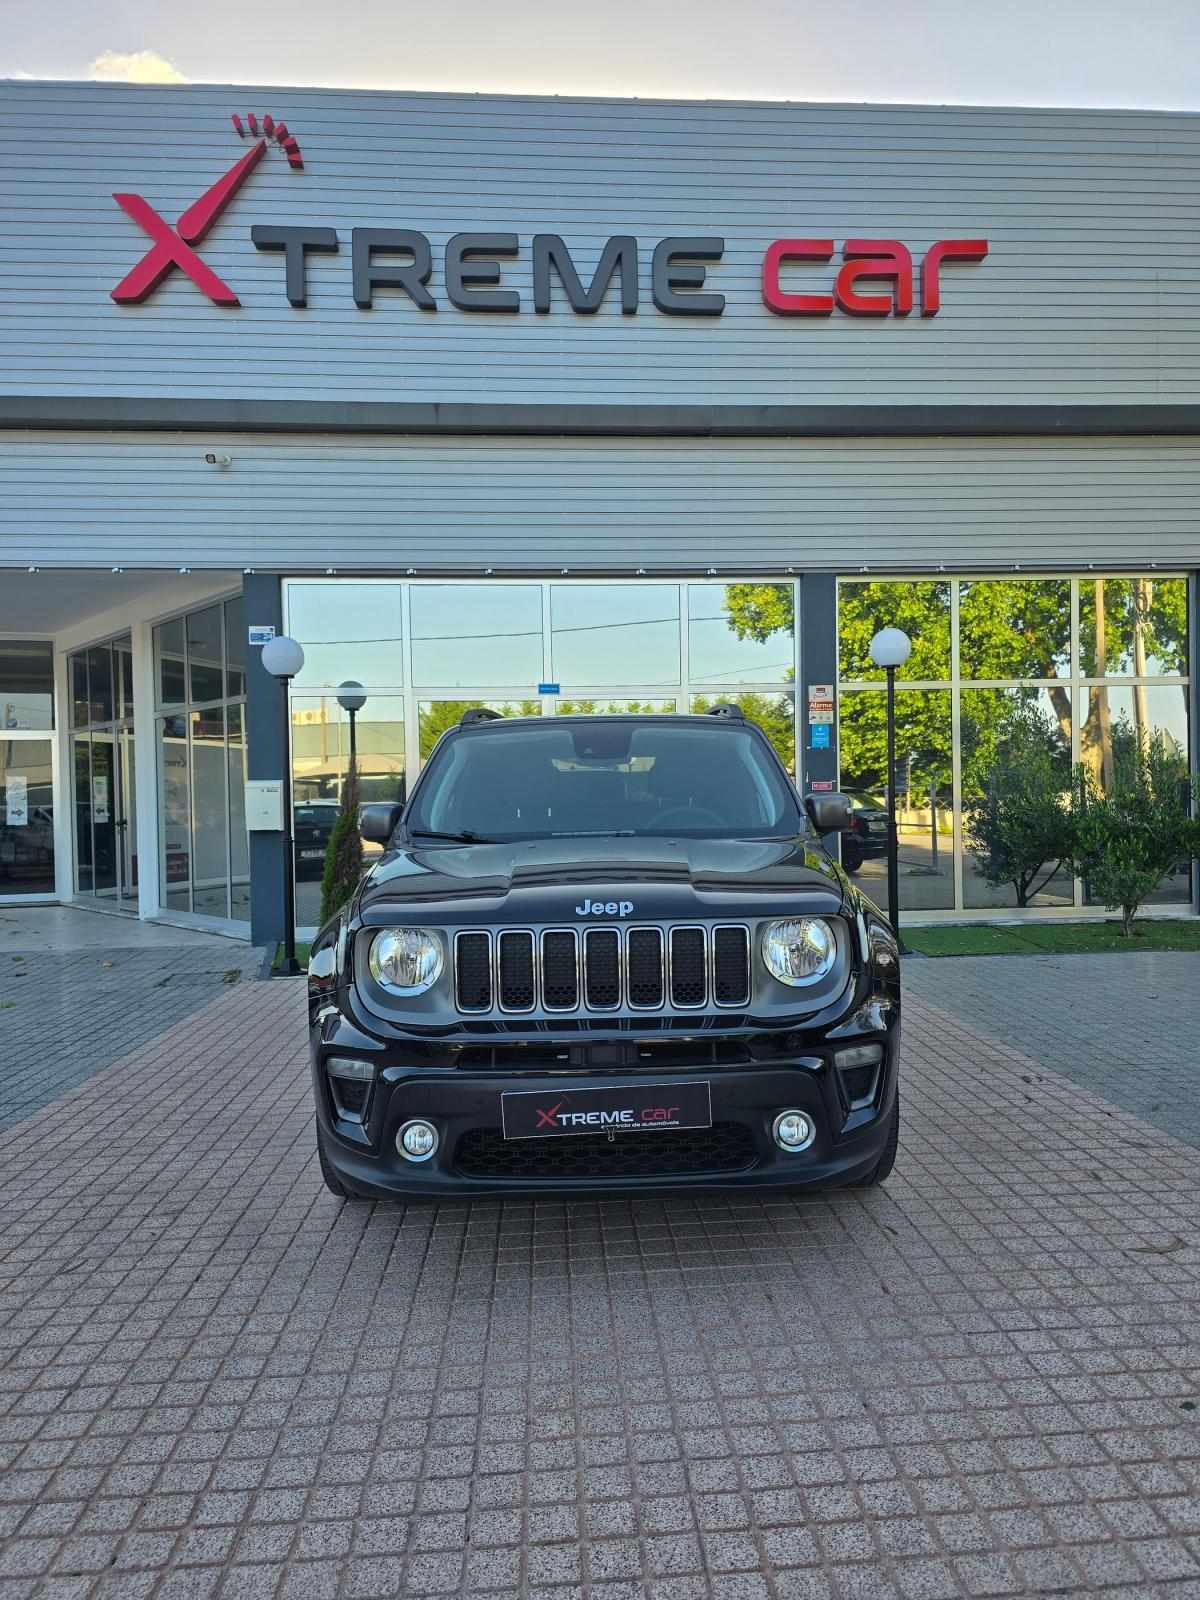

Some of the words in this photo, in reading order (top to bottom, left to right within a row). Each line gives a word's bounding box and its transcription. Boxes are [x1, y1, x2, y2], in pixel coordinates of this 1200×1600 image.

[110, 136, 726, 316] XTREME
[762, 238, 989, 318] car
[575, 899, 634, 917] Jeep
[535, 1103, 634, 1128] XTREME
[641, 1107, 681, 1122] car
